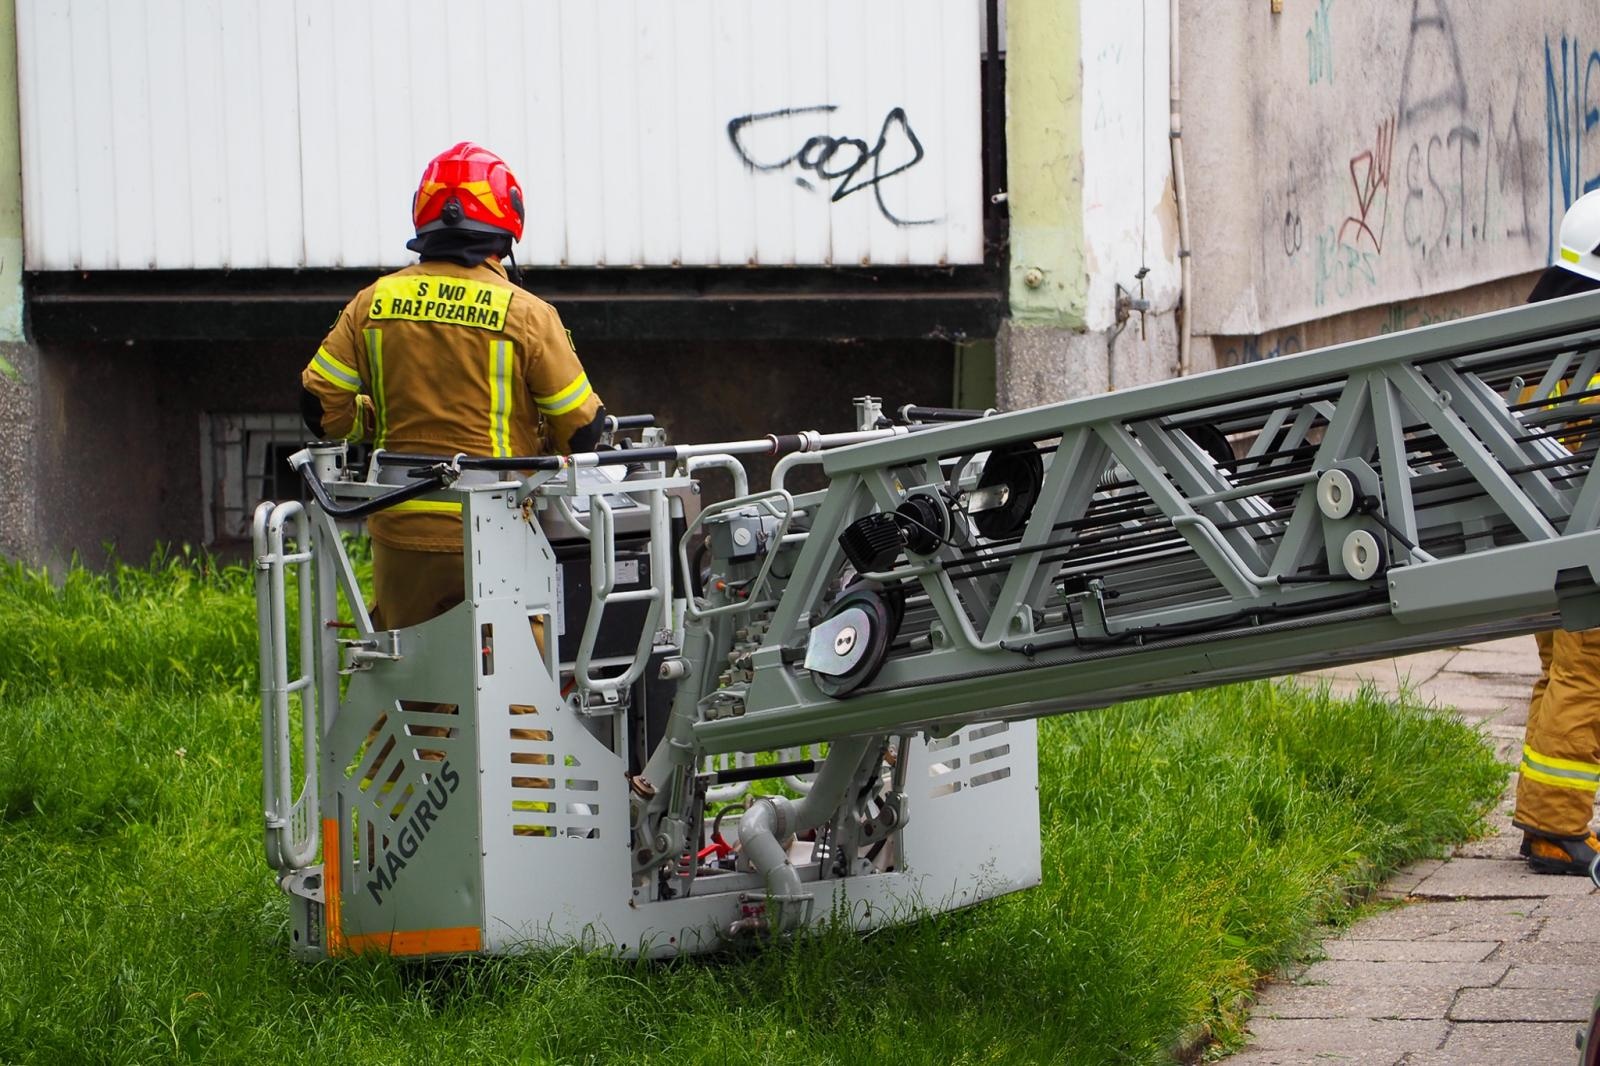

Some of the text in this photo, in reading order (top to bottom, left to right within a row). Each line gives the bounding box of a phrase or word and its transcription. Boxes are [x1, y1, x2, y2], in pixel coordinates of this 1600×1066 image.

[372, 298, 500, 327] SRAŻ POŻARNA
[366, 761, 460, 906] MAGIRUS
